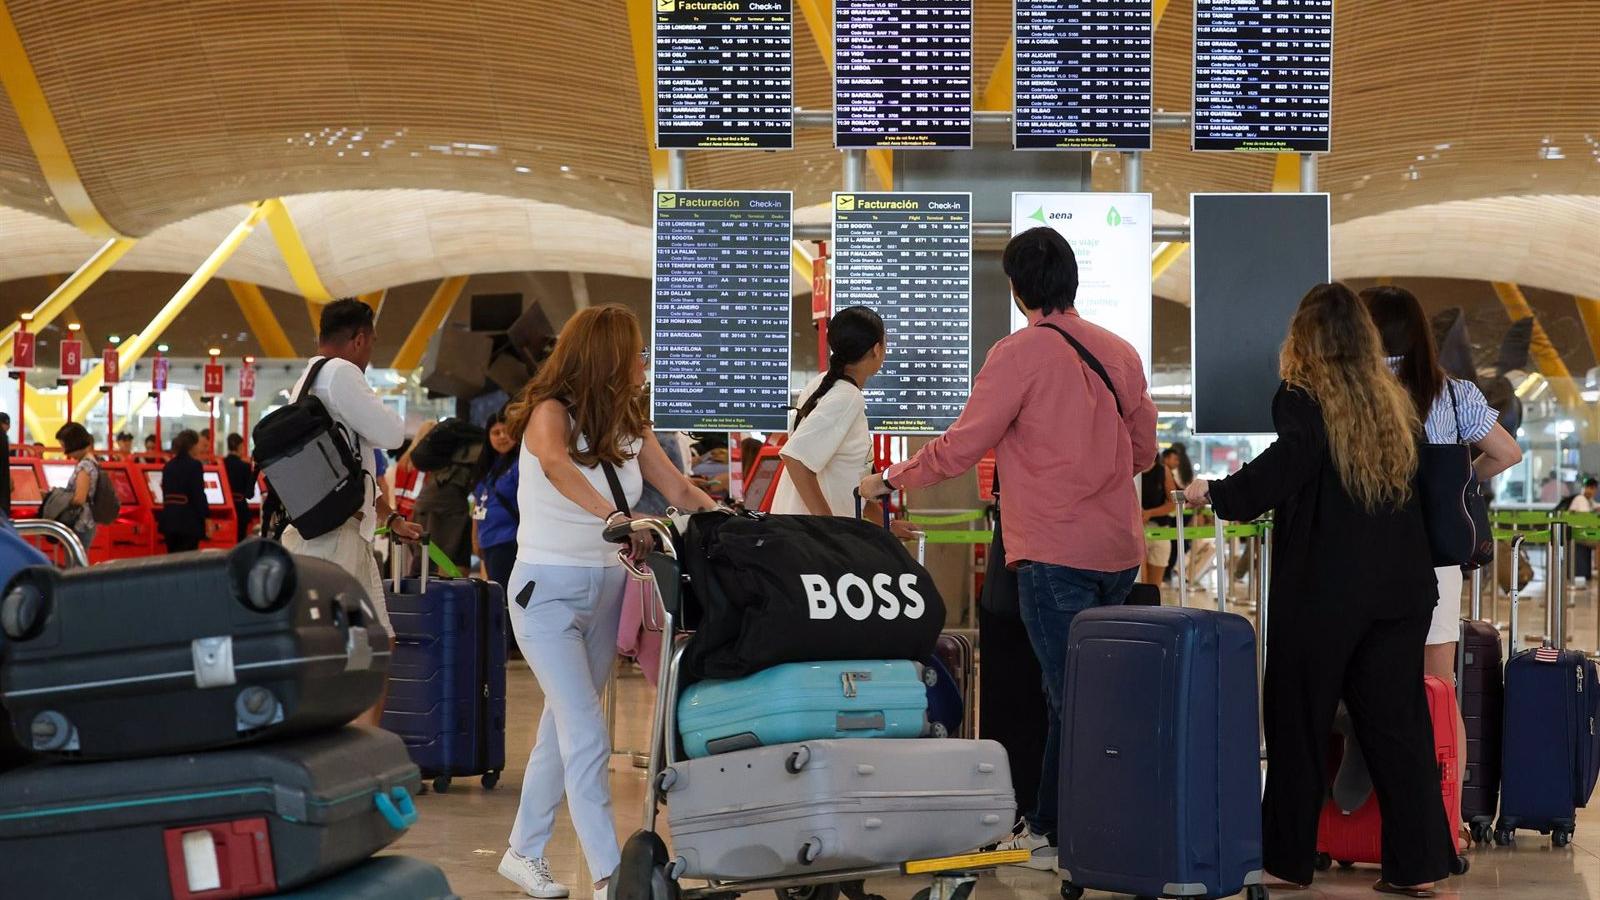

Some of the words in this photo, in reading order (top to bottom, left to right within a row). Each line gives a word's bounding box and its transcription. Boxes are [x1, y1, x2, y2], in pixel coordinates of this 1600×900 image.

[679, 1, 739, 10] Facturación
[680, 198, 739, 207] Facturación
[858, 200, 918, 209] Facturación
[1049, 212, 1072, 220] aena
[815, 276, 824, 295] 22
[21, 343, 28, 357] 7
[68, 352, 75, 365] 8
[110, 361, 115, 374] 9
[208, 373, 220, 385] 11
[800, 573, 925, 620] BOSS
